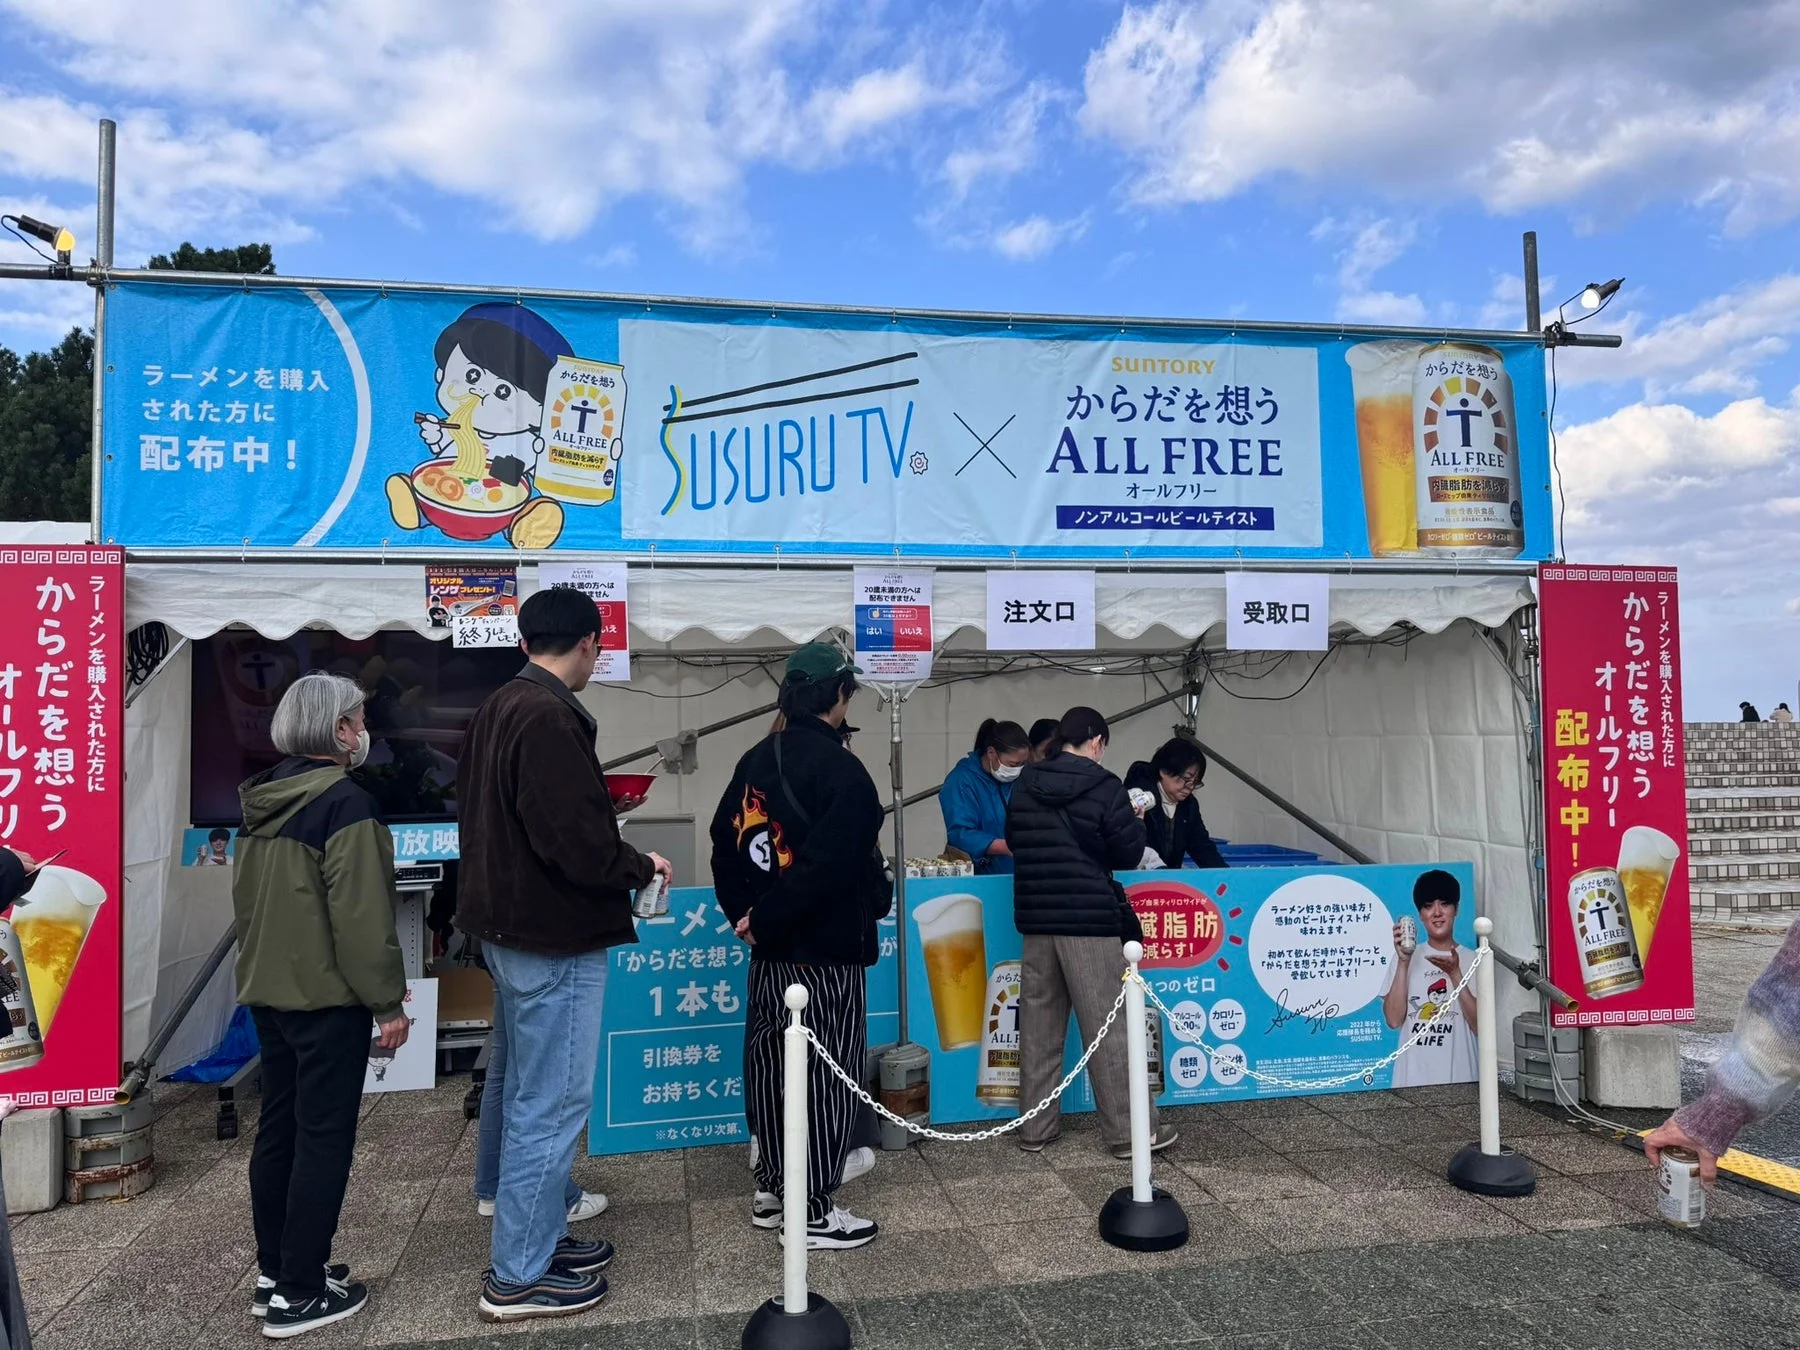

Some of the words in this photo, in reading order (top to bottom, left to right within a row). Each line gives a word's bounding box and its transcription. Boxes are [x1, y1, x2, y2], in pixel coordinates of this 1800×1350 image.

[1111, 357, 1216, 375] SUNTORY
[1425, 361, 1498, 381] からだを想う
[142, 364, 330, 391] ラーメンを購入
[560, 370, 616, 389] からだを想う
[142, 398, 276, 424] された方に
[1066, 384, 1280, 426] からだを想う
[552, 429, 577, 444] ALL
[578, 436, 608, 449] FREE
[139, 434, 297, 473] 配布中！
[660, 385, 836, 517] SUSURU
[1045, 426, 1150, 475] ALL
[1161, 437, 1284, 476] FREE
[1430, 450, 1462, 466] ALL
[1466, 451, 1505, 468] FREE
[1126, 483, 1217, 499] オールフリー
[1074, 510, 1258, 526] ノンアルコールビールテイスト
[430, 577, 464, 585] オリジナル
[430, 585, 460, 595] レンゲ
[864, 586, 922, 595] 20歳未満の方へは
[869, 594, 916, 603] 配布できません
[1003, 599, 1076, 623] 注文口
[1243, 601, 1311, 625] 受取口
[866, 627, 883, 636] はい
[900, 627, 924, 636] いいえ
[87, 575, 107, 793] ラーメンを購入された方に
[1657, 591, 1676, 768] ラーメンを購入された方に
[34, 576, 76, 831] からだを想う
[1622, 591, 1655, 799] からだを想う
[1595, 661, 1623, 828] オールフリー
[1555, 708, 1590, 868] 配布中！
[391, 828, 459, 857] 放映
[1271, 903, 1373, 915] ラーメン好きの強い味方！
[1275, 913, 1371, 926] 感動のビールテイストが
[1300, 926, 1348, 936] 味わえます。
[1585, 933, 1603, 946] ALL
[1603, 927, 1627, 941] FREE
[617, 944, 751, 973] 「からだを想う
[1174, 1012, 1202, 1020] アルコール
[1212, 1010, 1242, 1020] カロリー
[991, 1032, 1012, 1043] ALL
[1416, 1035, 1445, 1047] LIFE
[643, 1043, 722, 1069] 引換券を
[1179, 1056, 1198, 1067] 糖類
[643, 1076, 742, 1105] お持ちくだ
